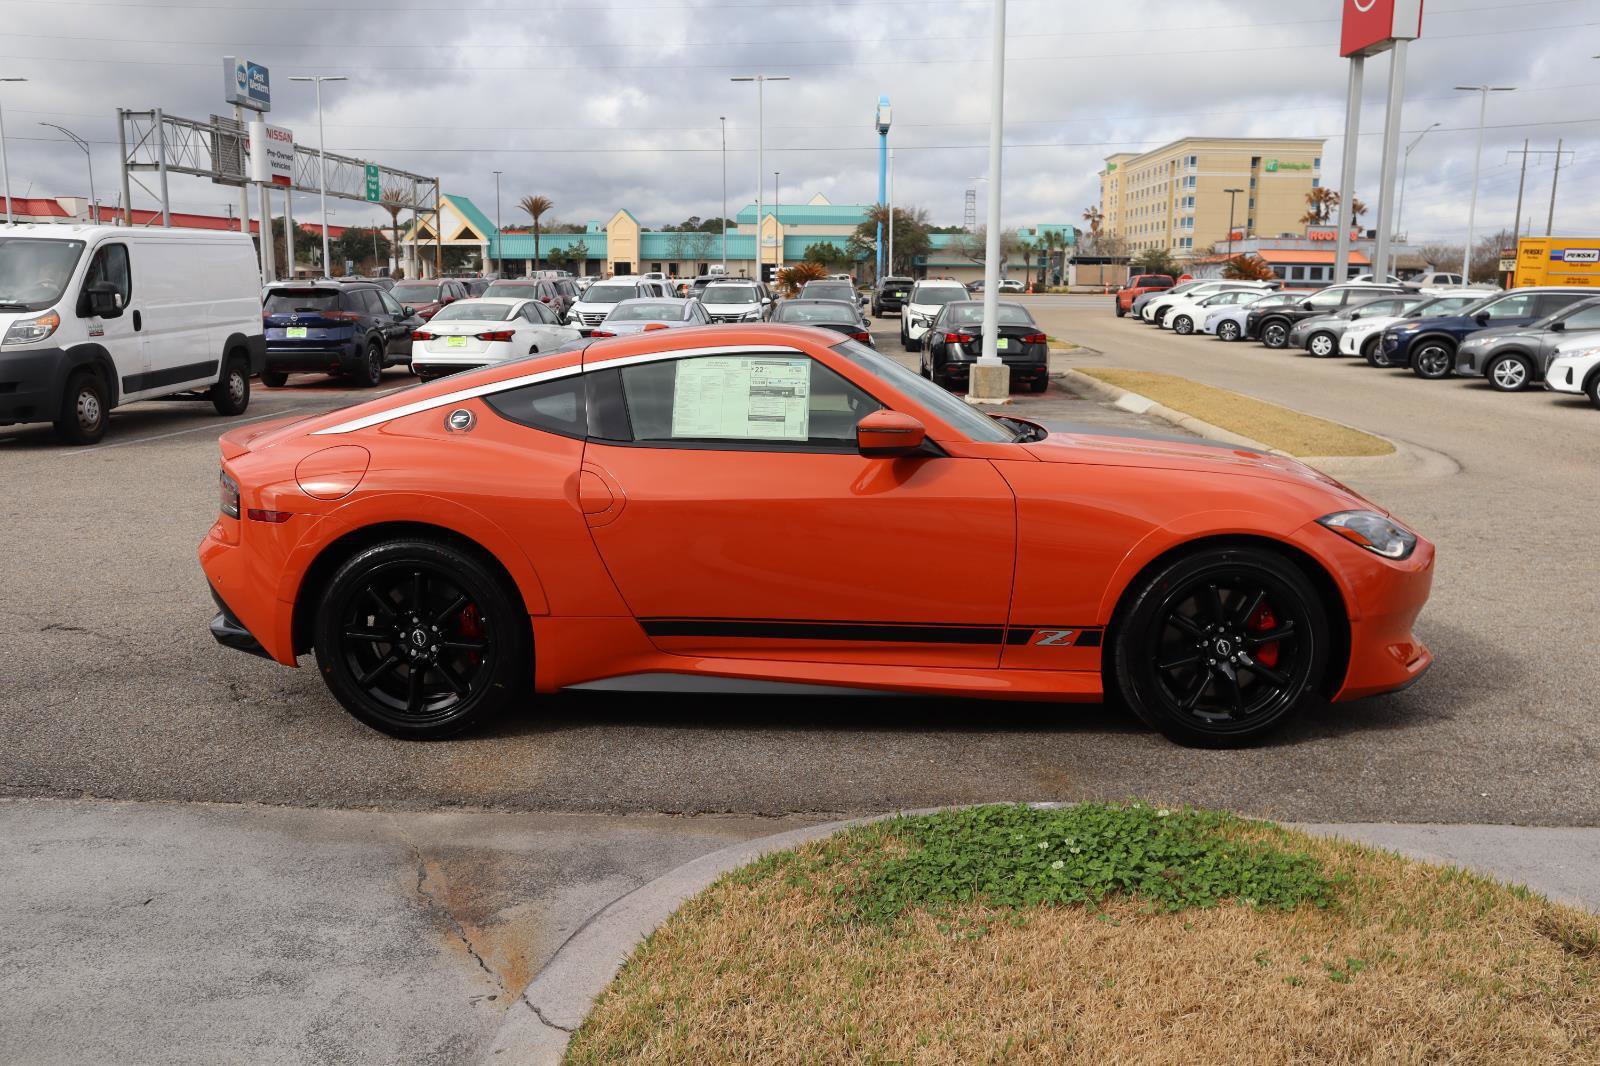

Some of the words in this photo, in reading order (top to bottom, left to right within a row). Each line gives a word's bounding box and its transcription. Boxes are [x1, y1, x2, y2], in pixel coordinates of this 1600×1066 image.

[266, 127, 293, 144] NISSAN
[266, 148, 294, 161] Pre-Owned
[270, 160, 291, 171] Vehicles
[1035, 630, 1073, 646] Z
